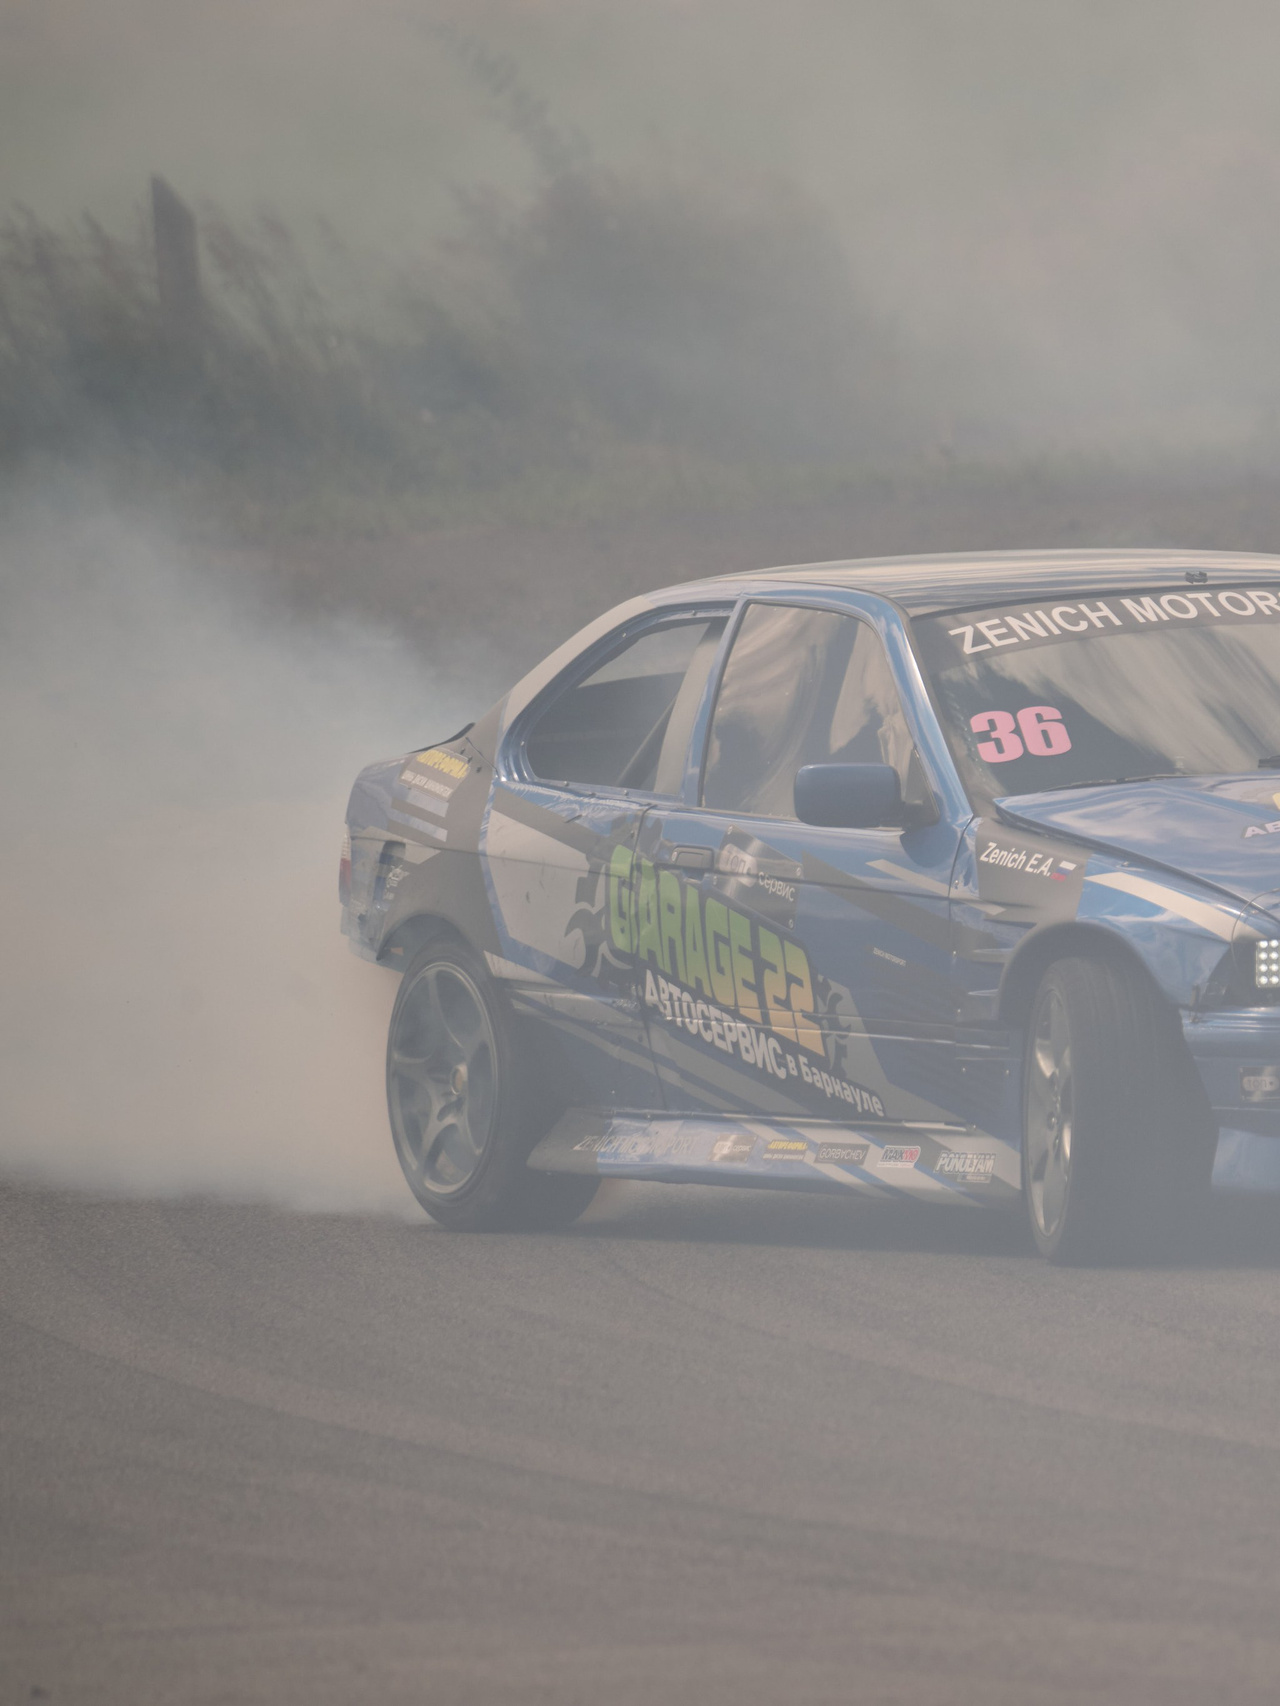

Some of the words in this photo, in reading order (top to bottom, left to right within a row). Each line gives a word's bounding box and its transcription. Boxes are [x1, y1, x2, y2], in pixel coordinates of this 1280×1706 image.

[948, 600, 1122, 655] ZENICH
[969, 705, 1073, 764] 36
[979, 841, 1027, 870] Zenich
[1024, 852, 1055, 877] E.A.
[609, 844, 763, 1025] GARAGE
[645, 969, 787, 1080] АВТОСЕРВИС
[798, 1055, 885, 1117] Барнауле
[881, 1147, 920, 1163] MAXMO
